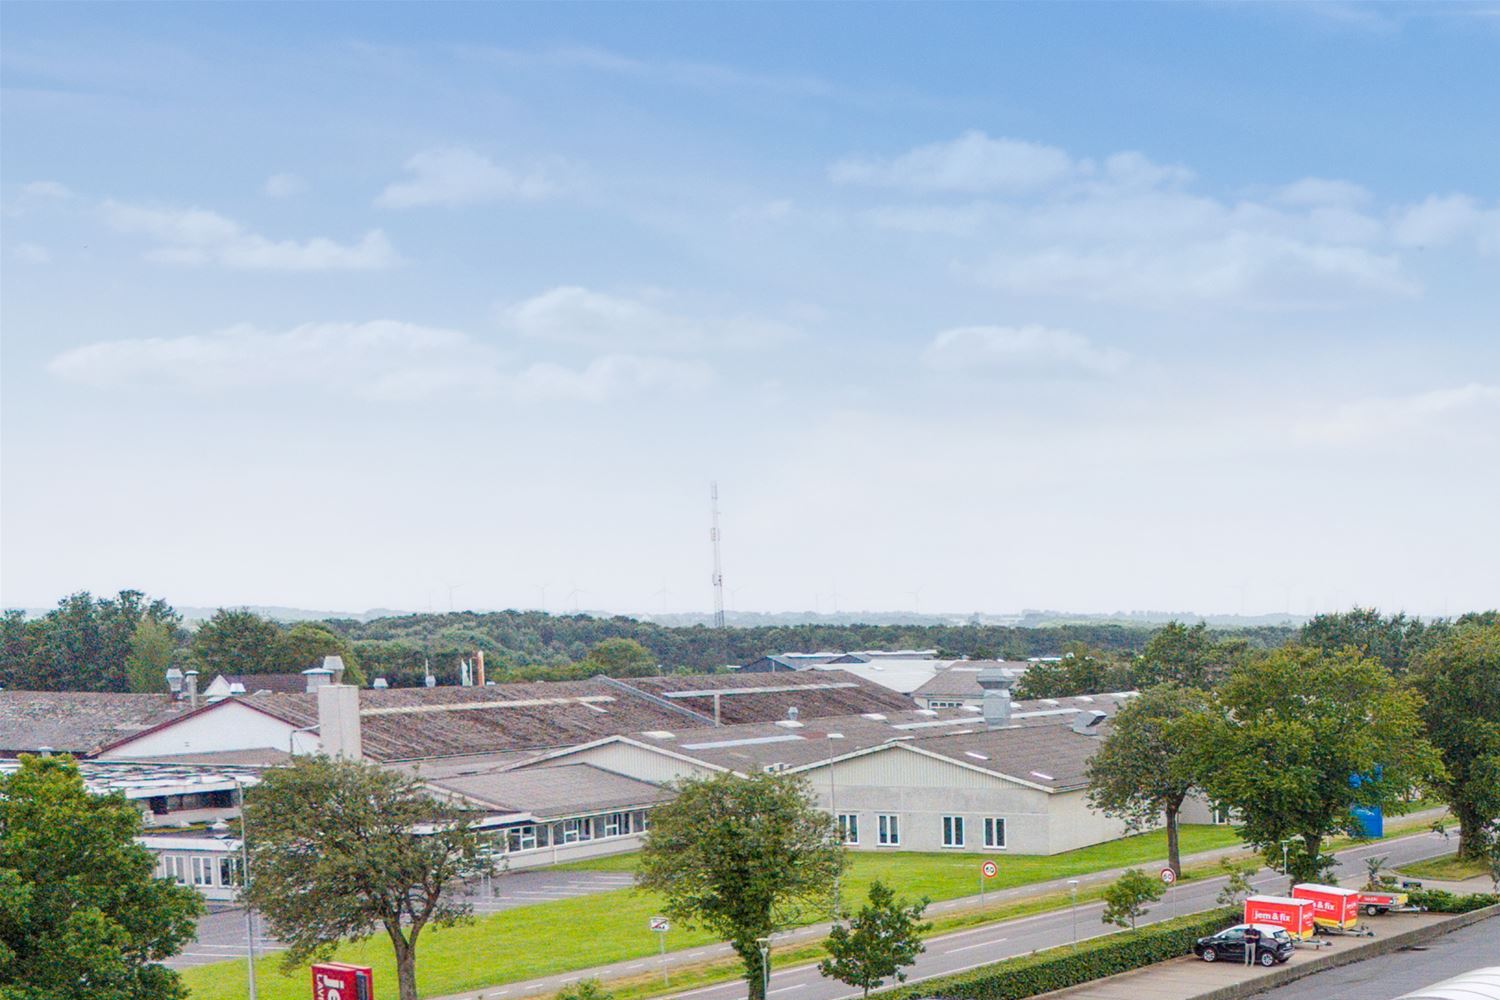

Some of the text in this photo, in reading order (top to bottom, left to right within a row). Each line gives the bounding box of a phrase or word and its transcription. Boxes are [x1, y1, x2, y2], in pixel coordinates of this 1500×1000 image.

[1324, 901, 1335, 910] fix
[1254, 910, 1291, 921] jem & fix
